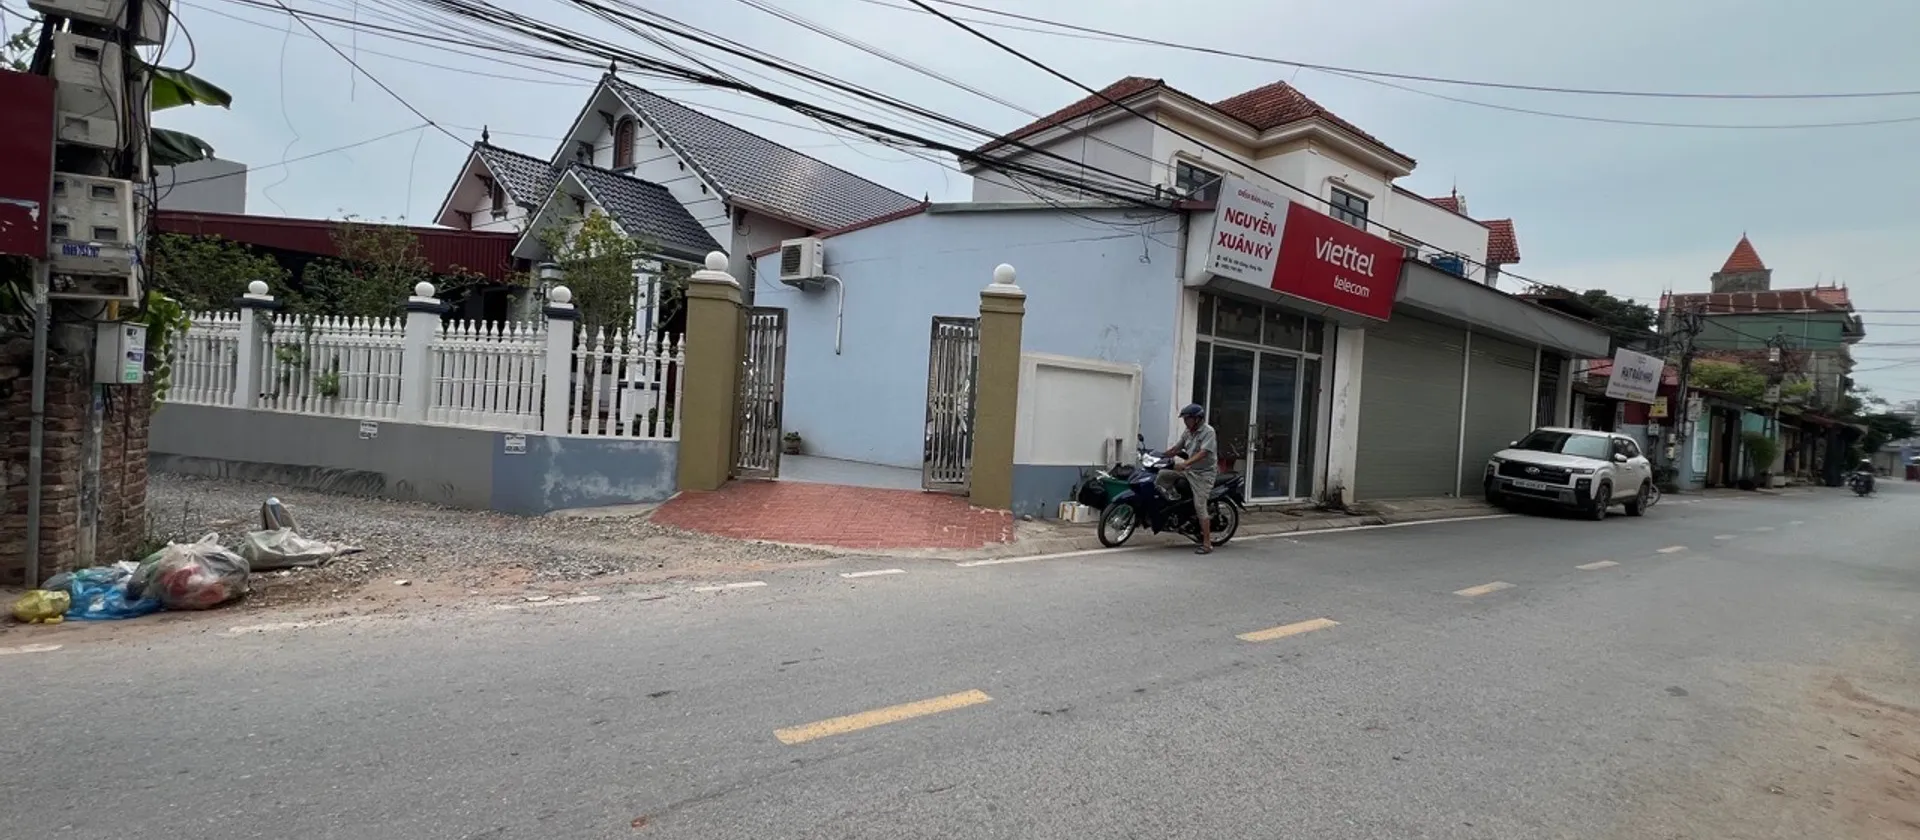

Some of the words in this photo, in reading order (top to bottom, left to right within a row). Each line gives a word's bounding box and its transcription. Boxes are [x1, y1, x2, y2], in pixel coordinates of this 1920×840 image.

[1223, 207, 1277, 237] NGUYỄN
[1217, 231, 1255, 255] XUÂN
[1315, 236, 1374, 277] viettel
[1333, 275, 1370, 298] telecom
